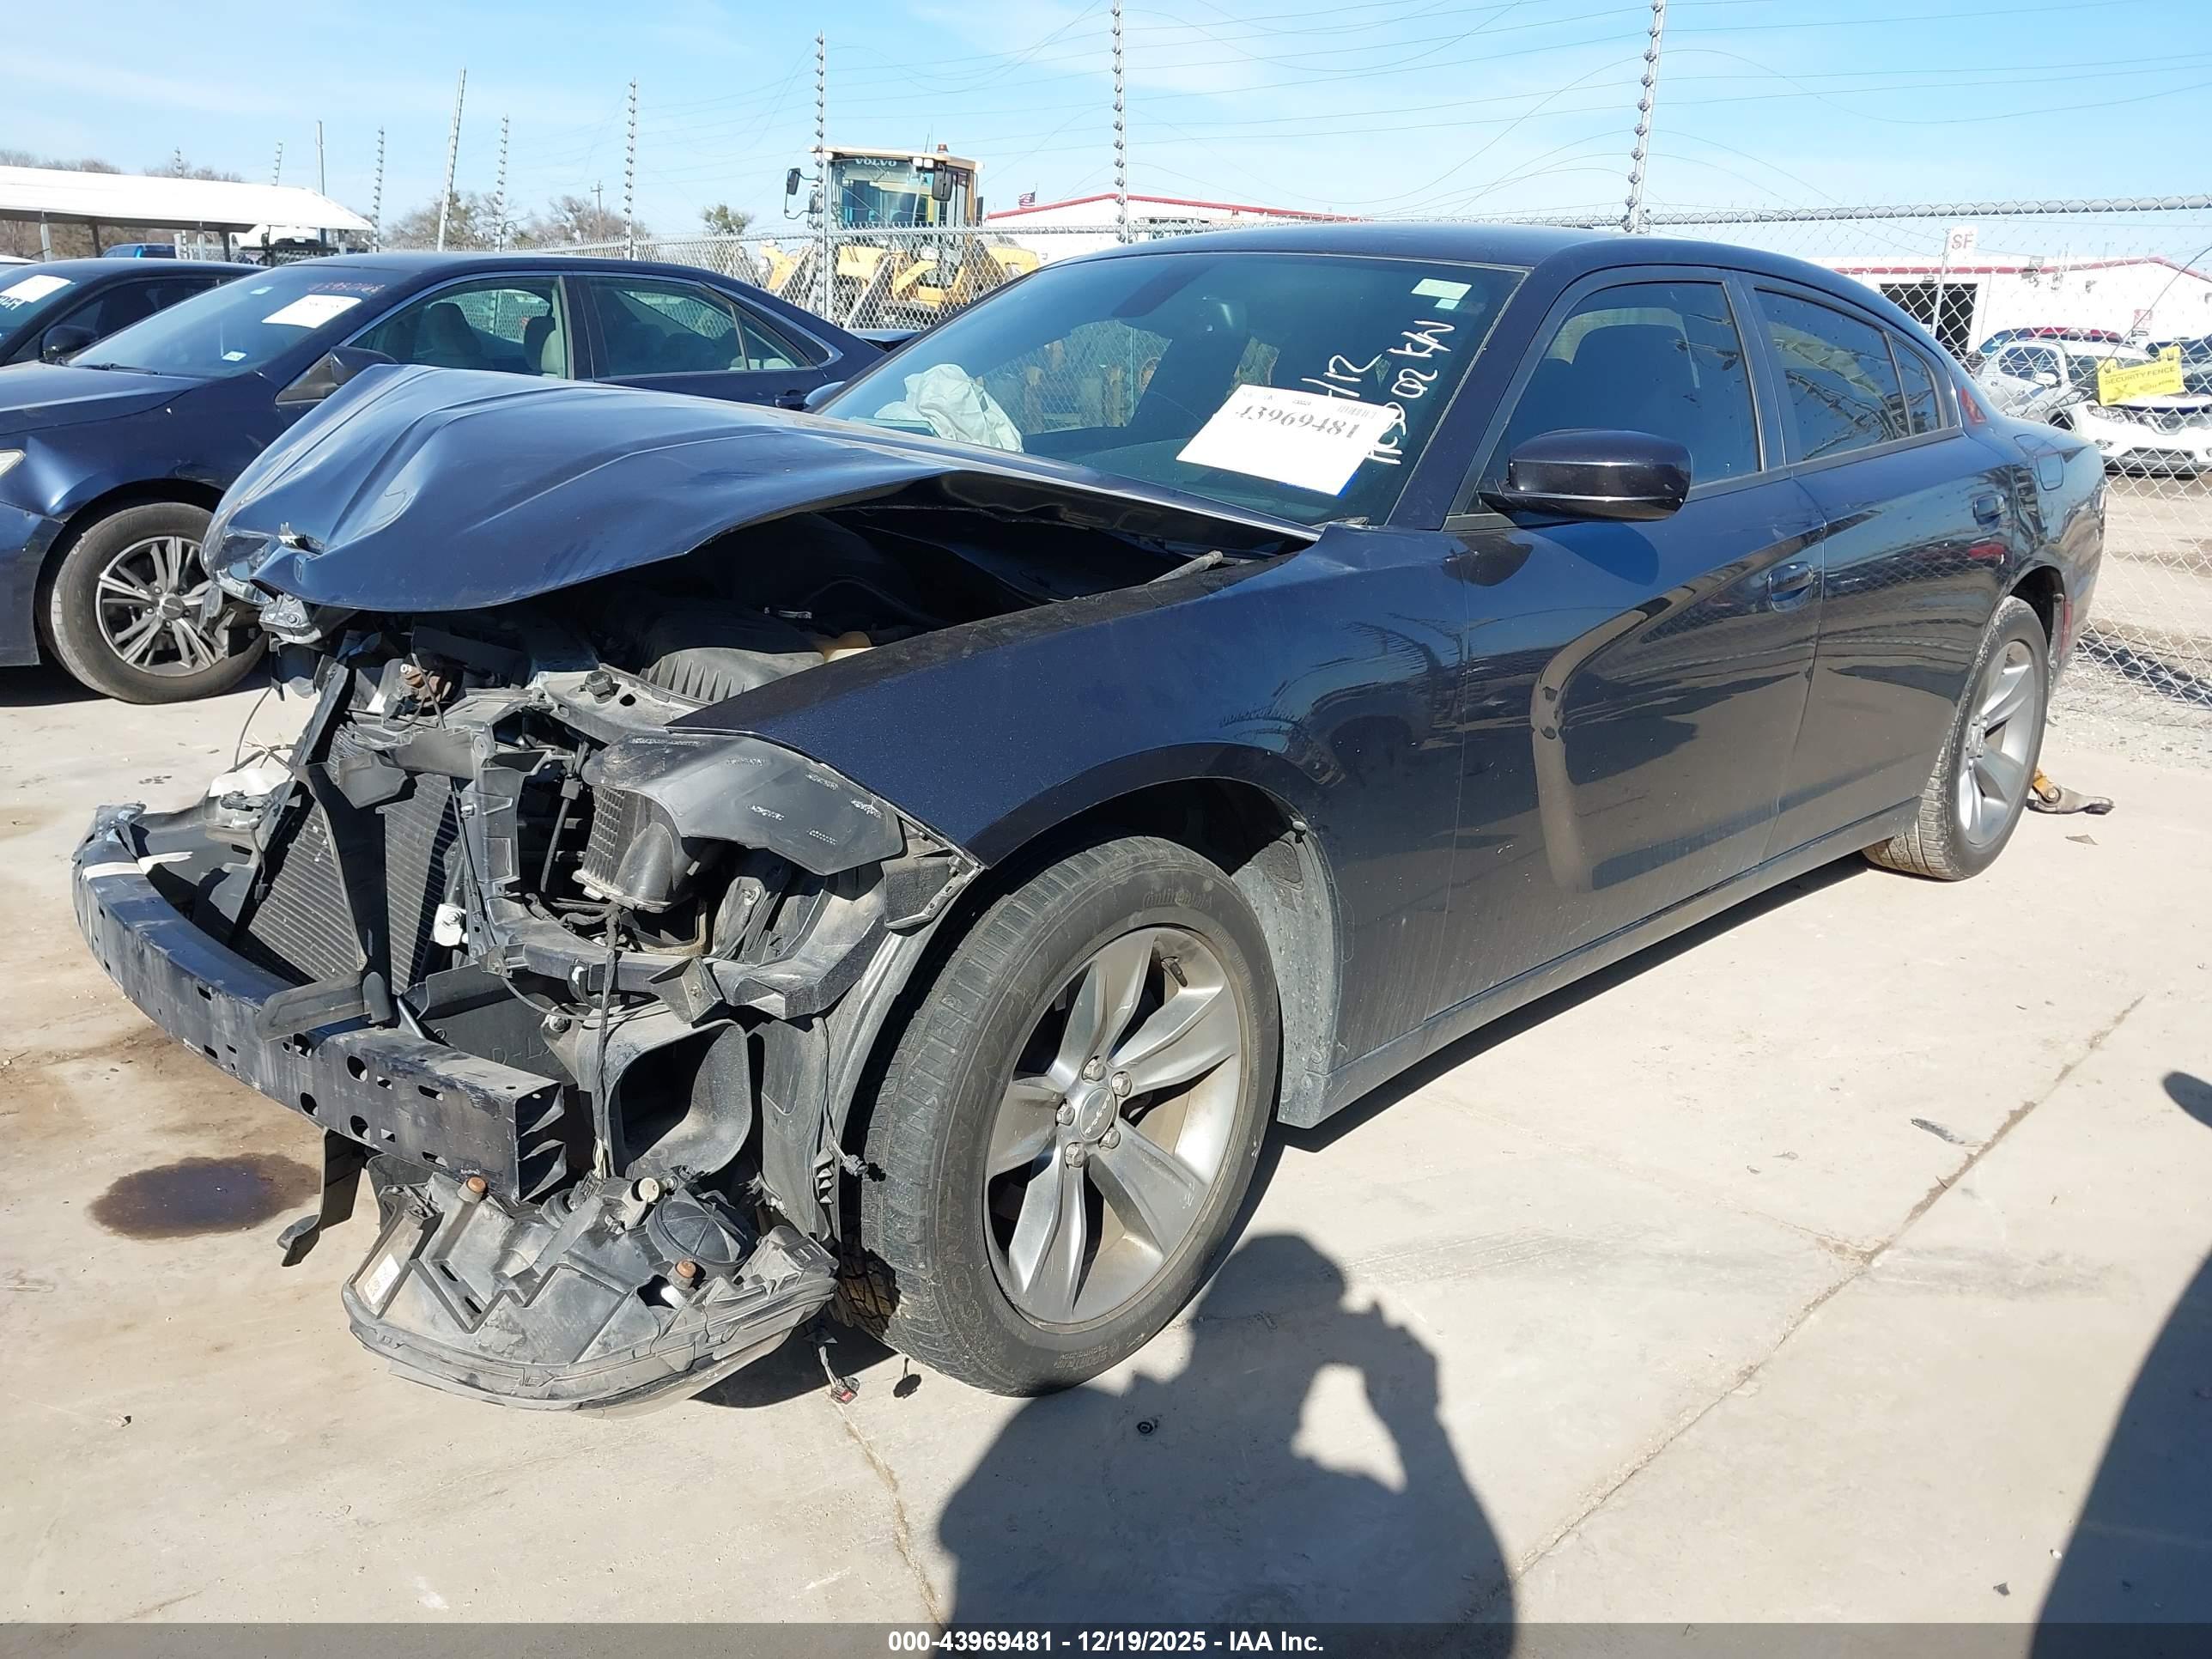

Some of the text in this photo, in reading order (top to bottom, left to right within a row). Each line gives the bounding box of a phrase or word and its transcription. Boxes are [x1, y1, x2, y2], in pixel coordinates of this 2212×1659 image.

[854, 158, 897, 167] VOLVO
[1951, 234, 1973, 250] SF
[2105, 372, 2146, 385] SECURITY
[2147, 366, 2176, 377] FENCE
